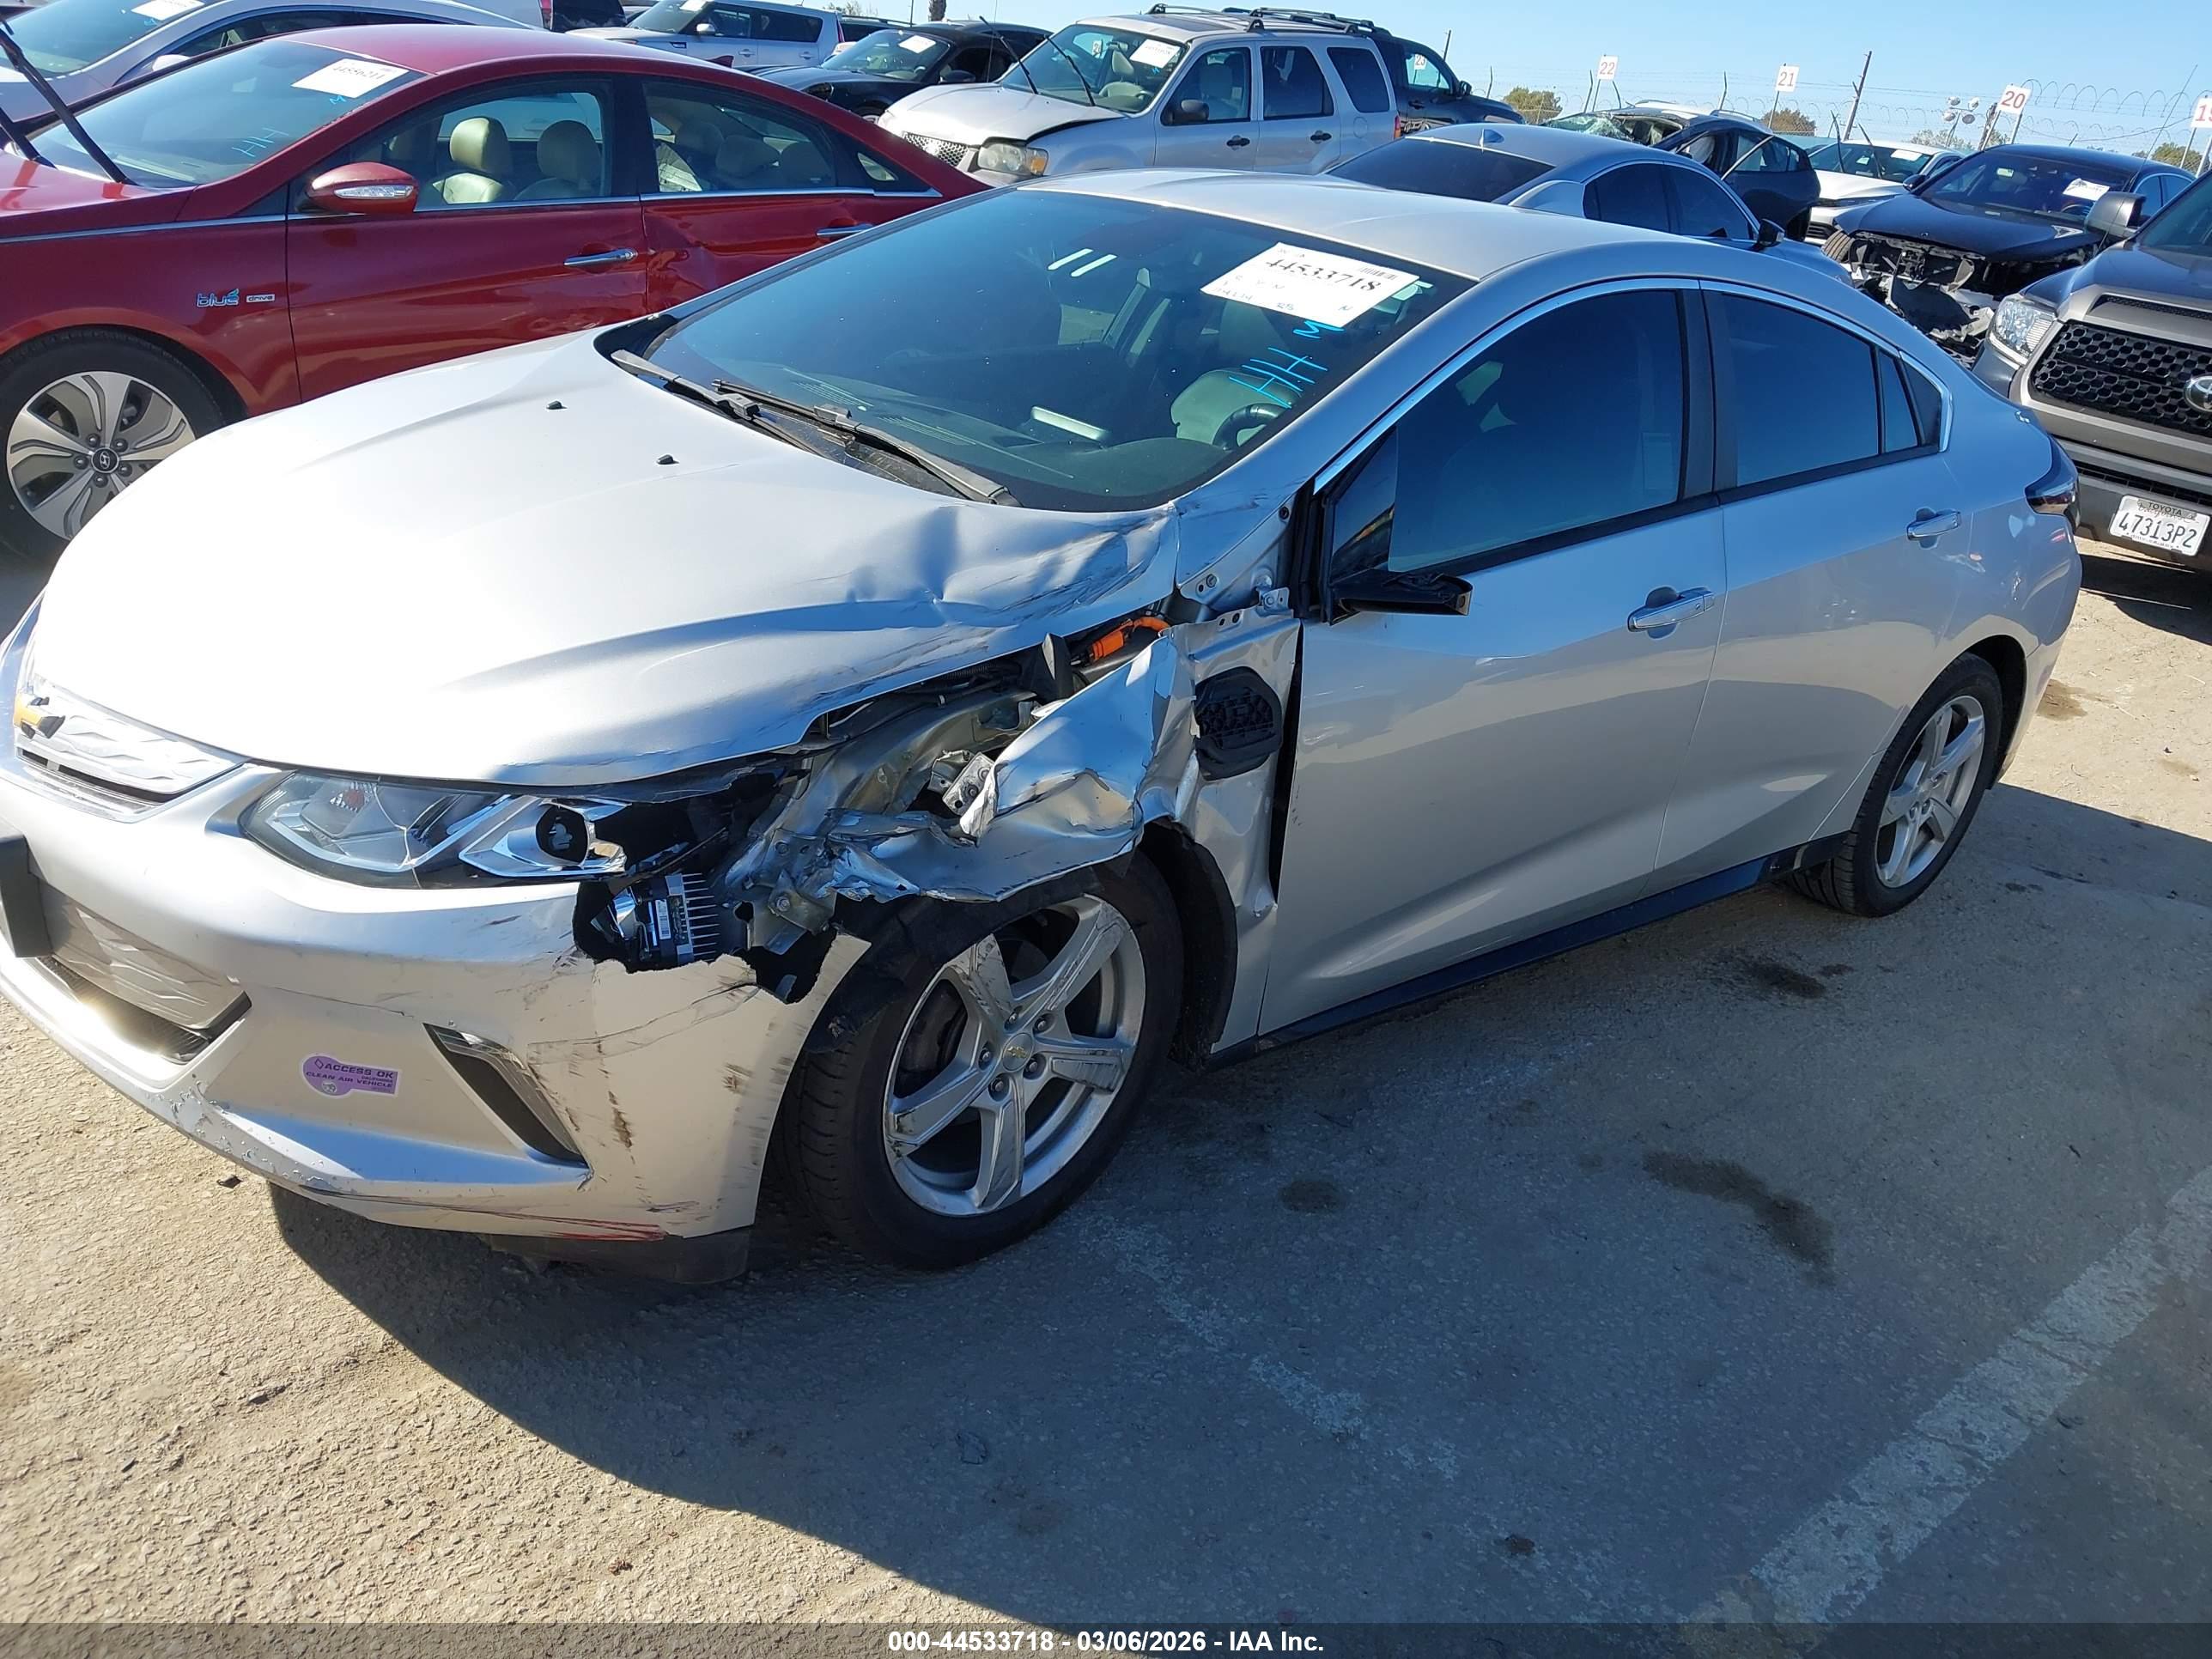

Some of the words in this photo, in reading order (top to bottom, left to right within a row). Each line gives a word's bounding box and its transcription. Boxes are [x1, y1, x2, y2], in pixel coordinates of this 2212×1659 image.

[1600, 61, 1614, 75] 22
[1778, 71, 1794, 87] 21
[2001, 90, 2026, 109] 20
[1266, 258, 1382, 292] 44533718
[197, 289, 240, 307] blue
[2148, 502, 2182, 515] TOYOTA
[2118, 512, 2197, 549] 47313P2
[306, 1071, 335, 1080] CLEAN
[357, 1079, 392, 1088] VEHICLE
[325, 1063, 372, 1076] ACCESS
[377, 1071, 394, 1079] OK
